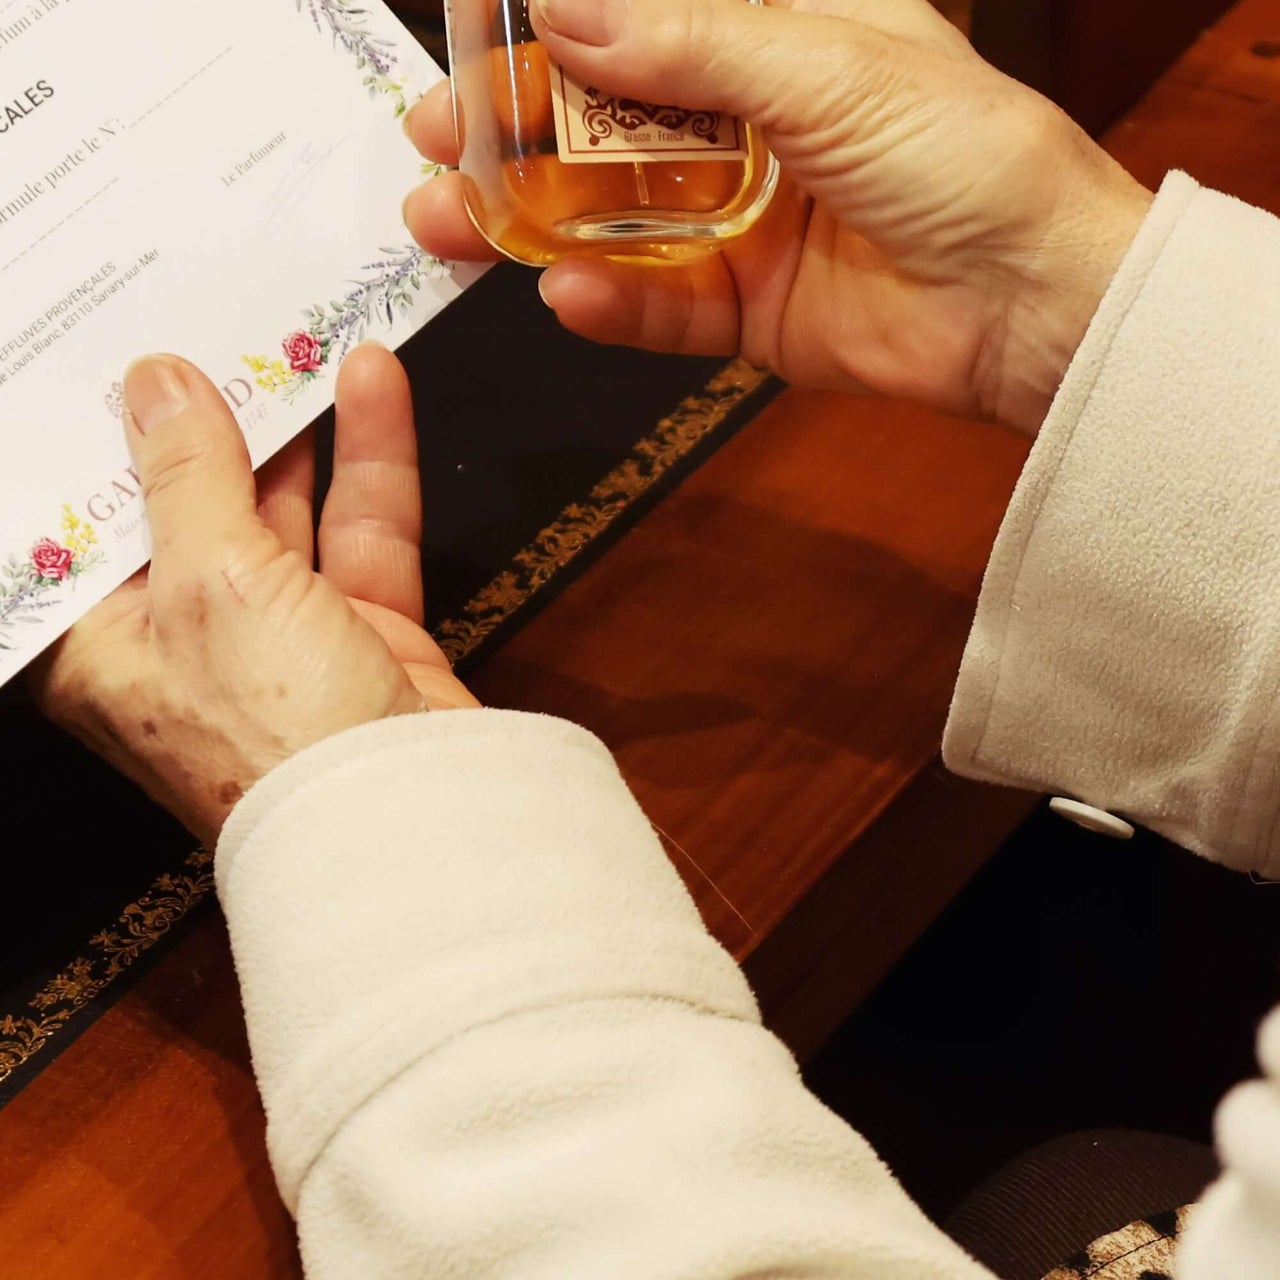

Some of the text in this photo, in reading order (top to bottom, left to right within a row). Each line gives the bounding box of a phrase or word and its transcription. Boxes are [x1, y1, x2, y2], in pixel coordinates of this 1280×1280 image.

[26, 4, 44, 21] à
[43, 149, 85, 189] porte
[80, 137, 100, 154] le
[233, 131, 287, 176] Parfumeur
[5, 351, 35, 376] Louis
[60, 301, 93, 332] 83110
[90, 248, 160, 306] Sanary-sur-Mer
[44, 261, 117, 322] PROVENÇALES
